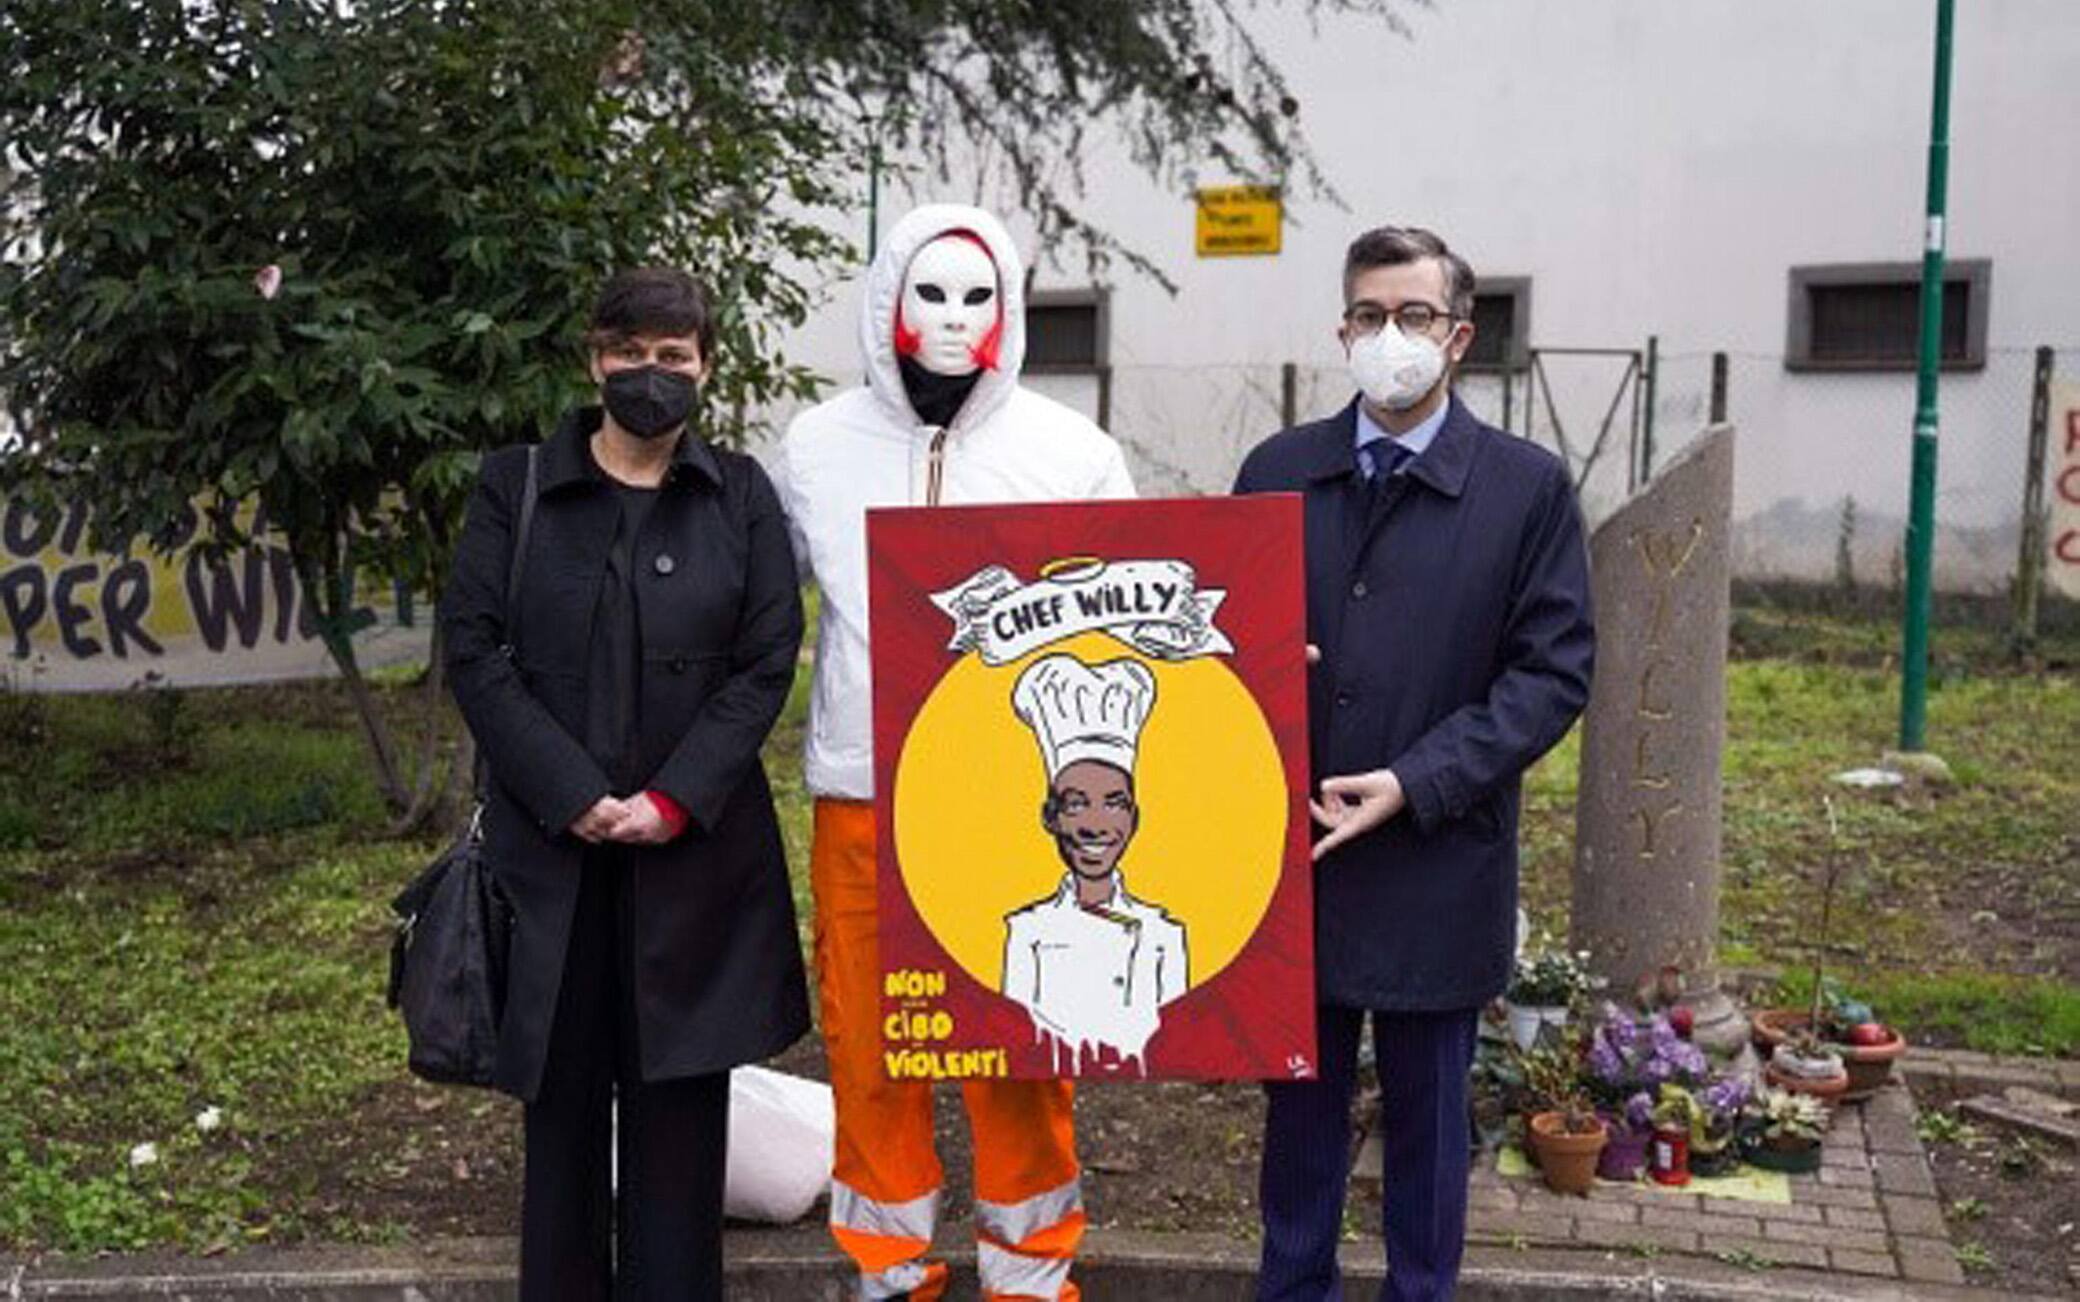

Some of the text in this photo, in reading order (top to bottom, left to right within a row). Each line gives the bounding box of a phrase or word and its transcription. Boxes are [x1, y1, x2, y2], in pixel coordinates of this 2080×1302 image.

[0, 559, 164, 660] PER
[992, 594, 1065, 641] CHEF
[884, 969, 946, 998] NON
